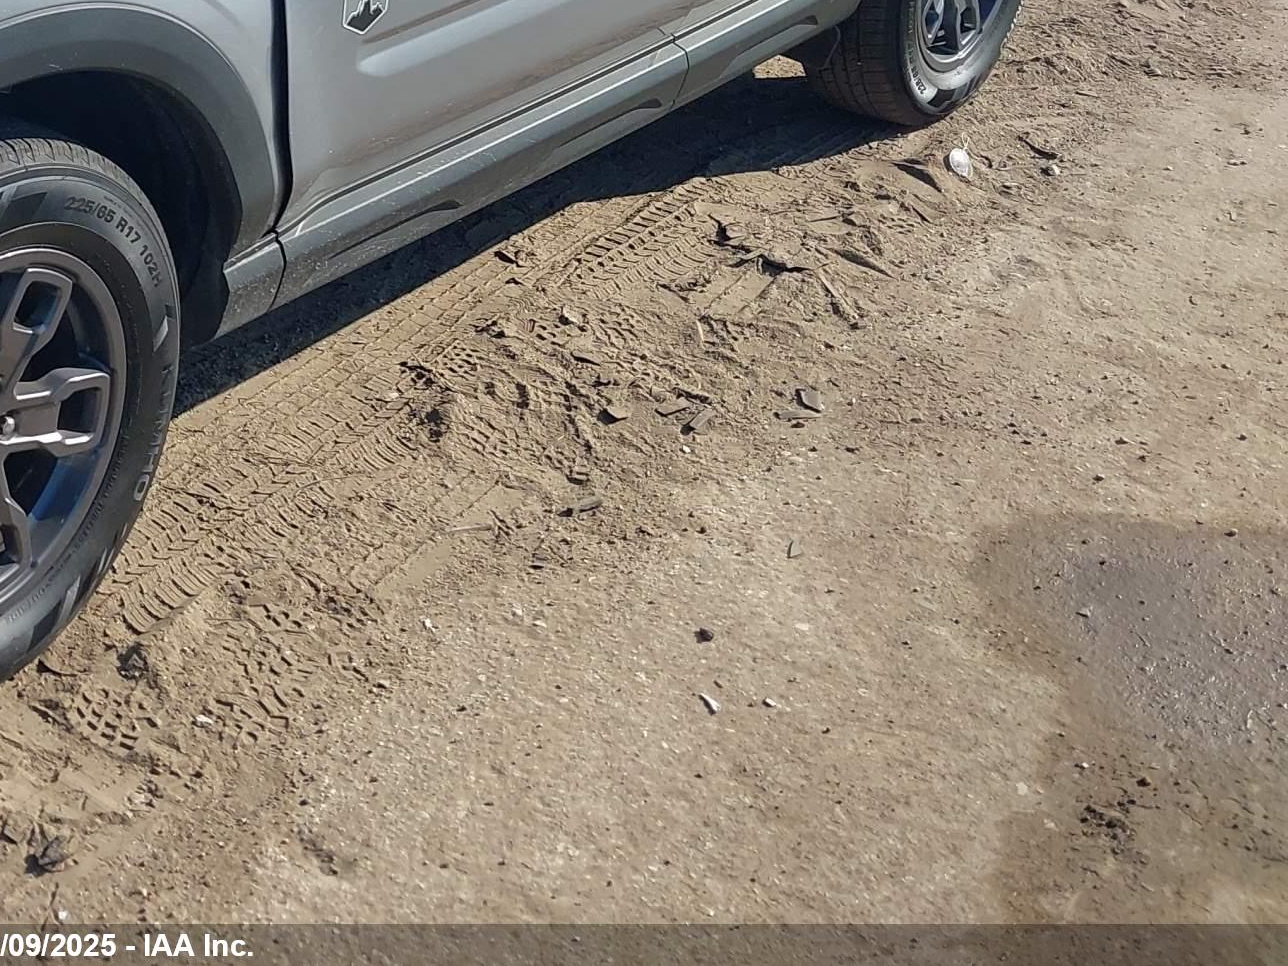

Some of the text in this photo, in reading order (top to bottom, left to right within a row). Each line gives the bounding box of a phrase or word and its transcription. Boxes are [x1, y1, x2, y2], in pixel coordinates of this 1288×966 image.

[64, 196, 117, 223] 225/65
[115, 216, 142, 244] R17
[139, 244, 162, 288] 102H
